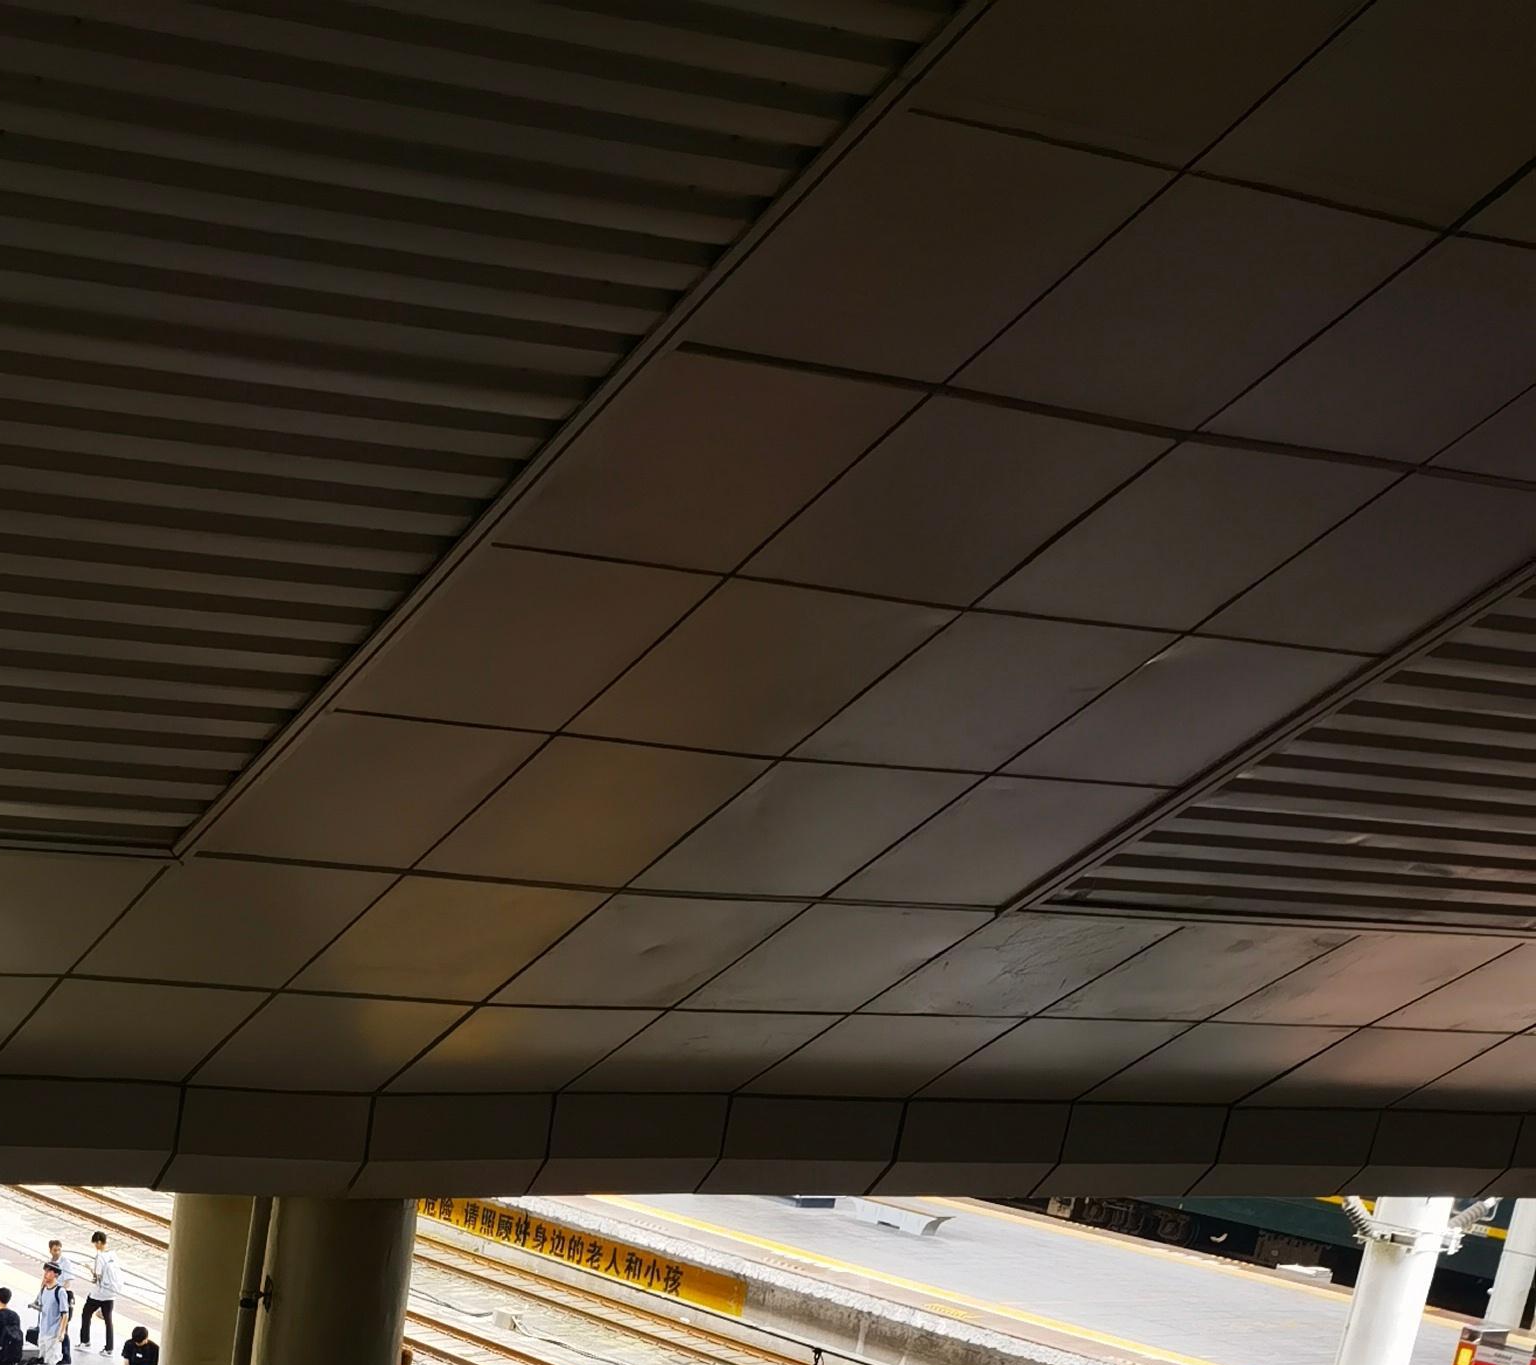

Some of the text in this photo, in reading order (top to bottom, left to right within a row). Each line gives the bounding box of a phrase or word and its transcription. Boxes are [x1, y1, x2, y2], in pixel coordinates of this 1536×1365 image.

[416, 1198, 683, 1297] 危险，请照顾好身边的老人和小孩
